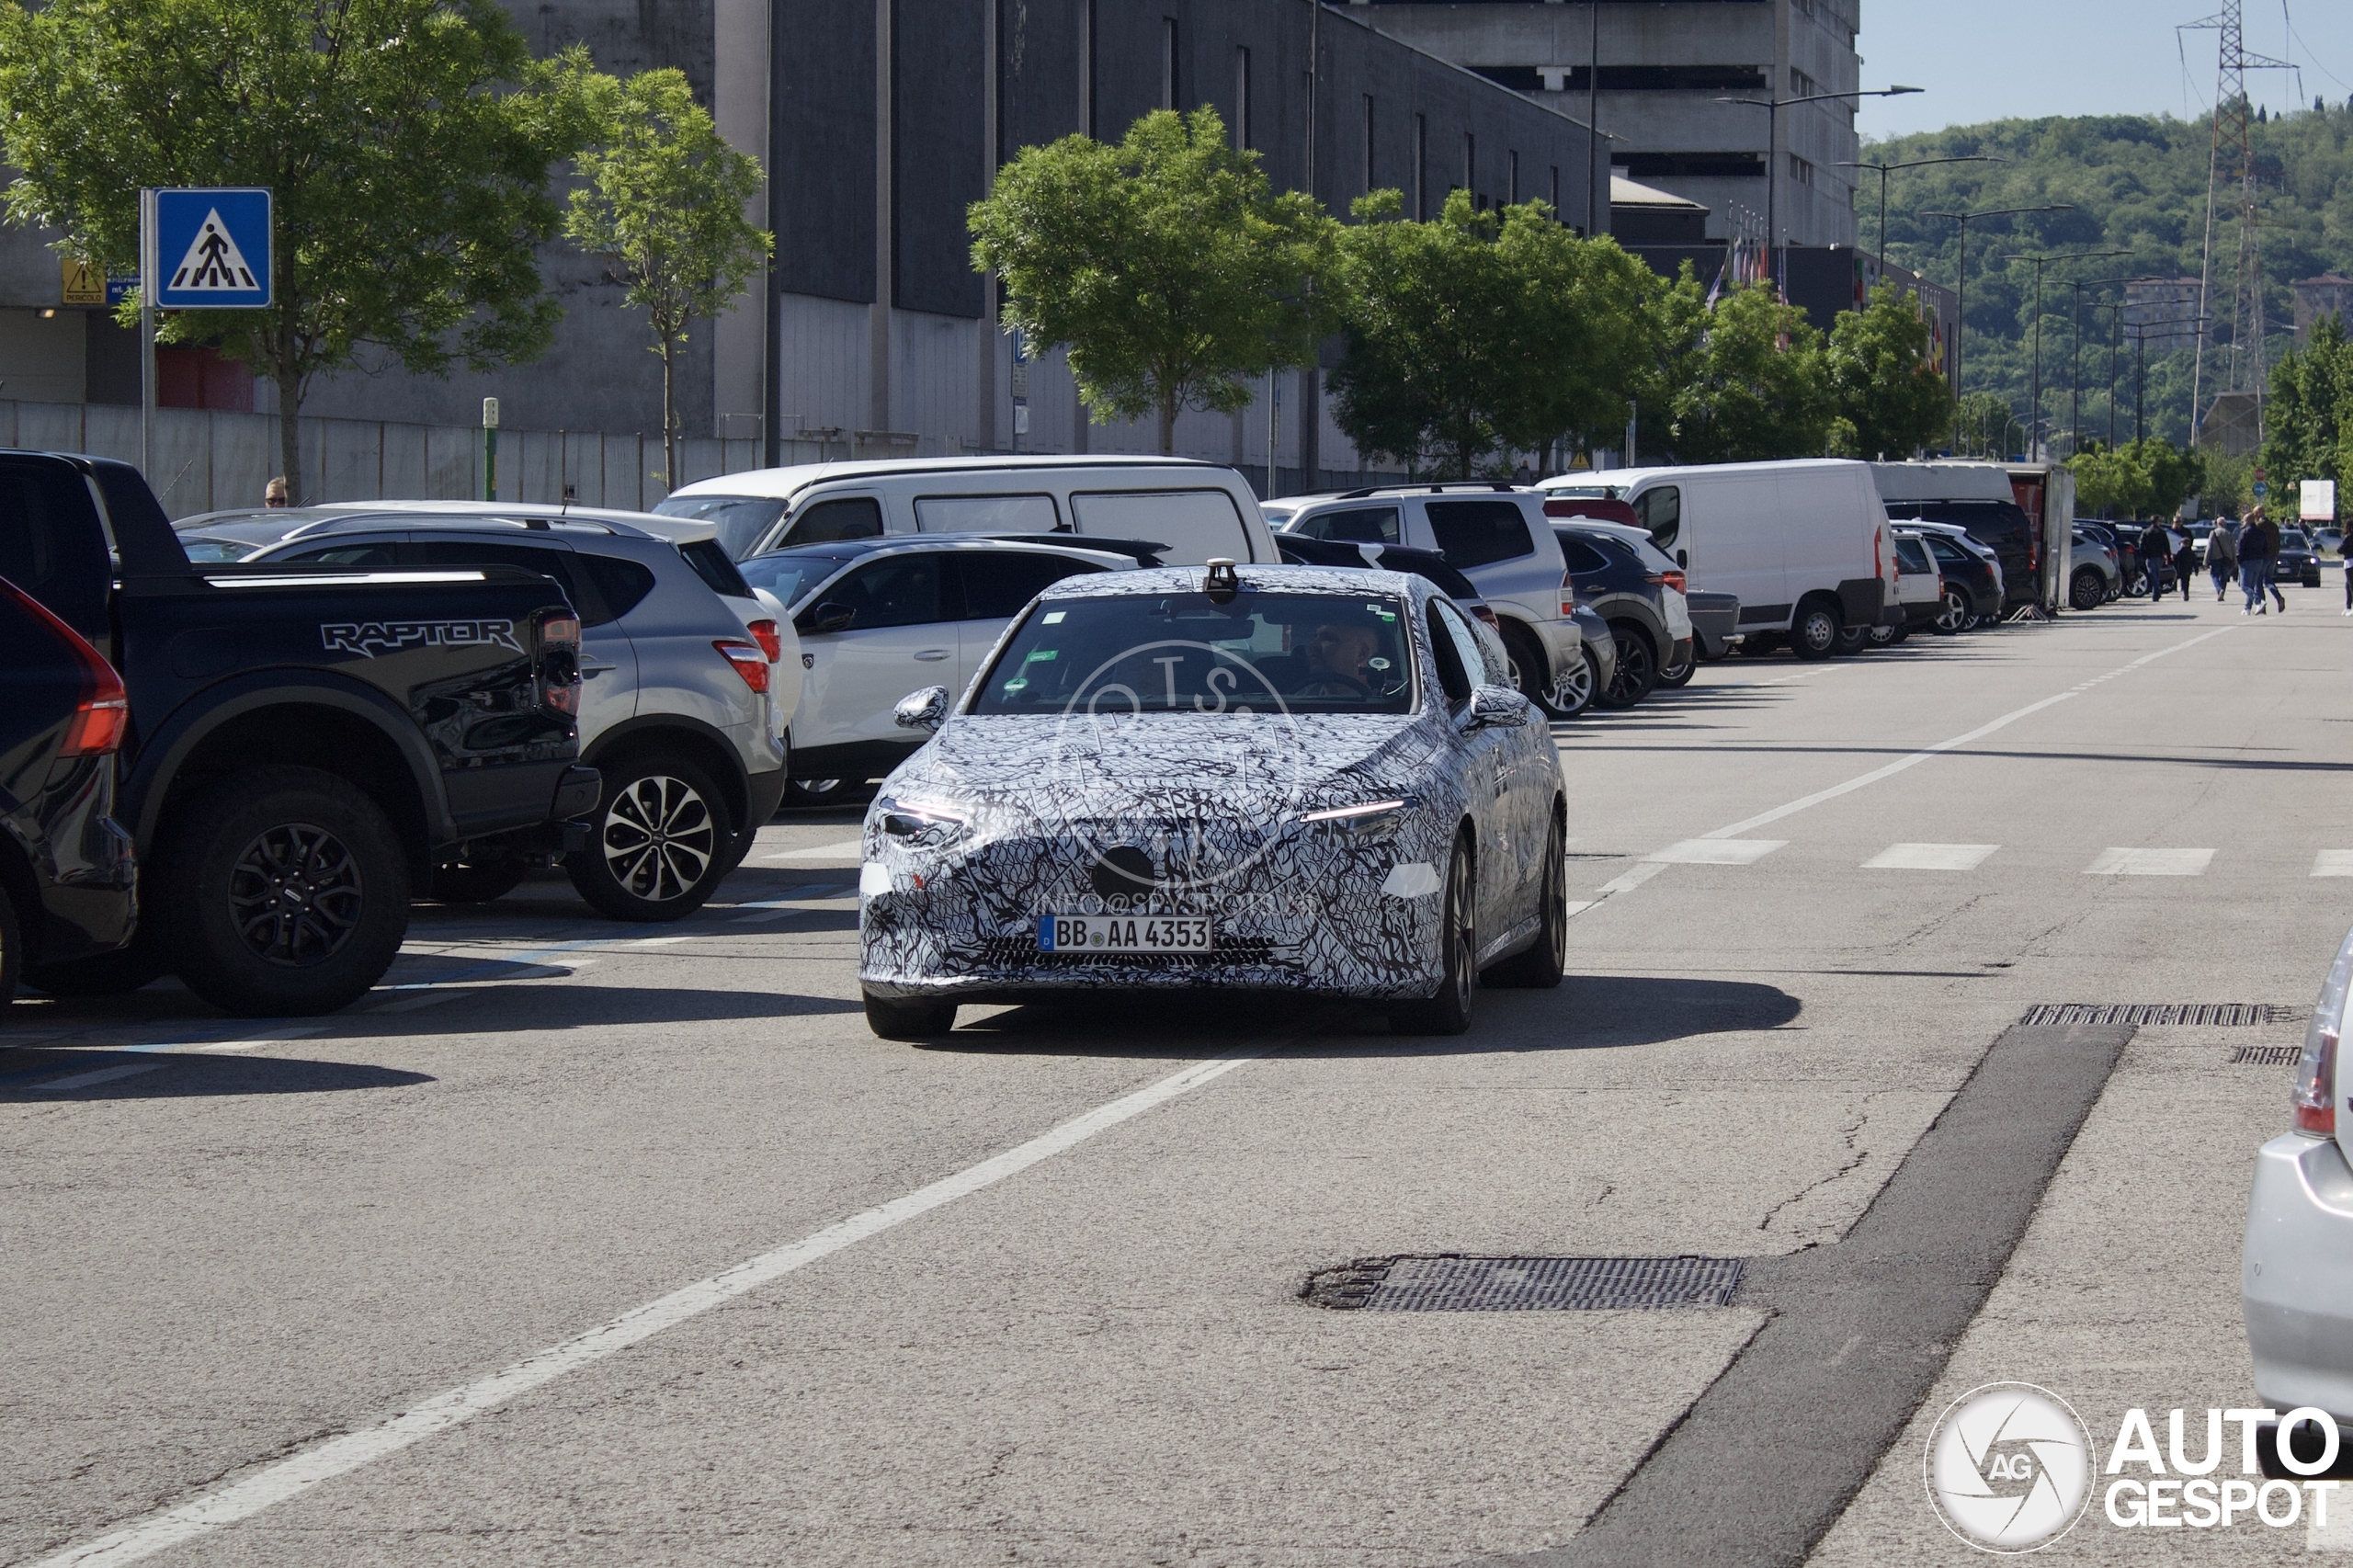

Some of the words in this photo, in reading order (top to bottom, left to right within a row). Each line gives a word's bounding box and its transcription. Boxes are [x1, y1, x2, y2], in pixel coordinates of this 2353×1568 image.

[321, 619, 526, 659] RAPTOR
[1043, 937, 1050, 946] D
[1056, 920, 1087, 947] BB
[1108, 920, 1138, 947] AA
[1144, 920, 1207, 948] 4353
